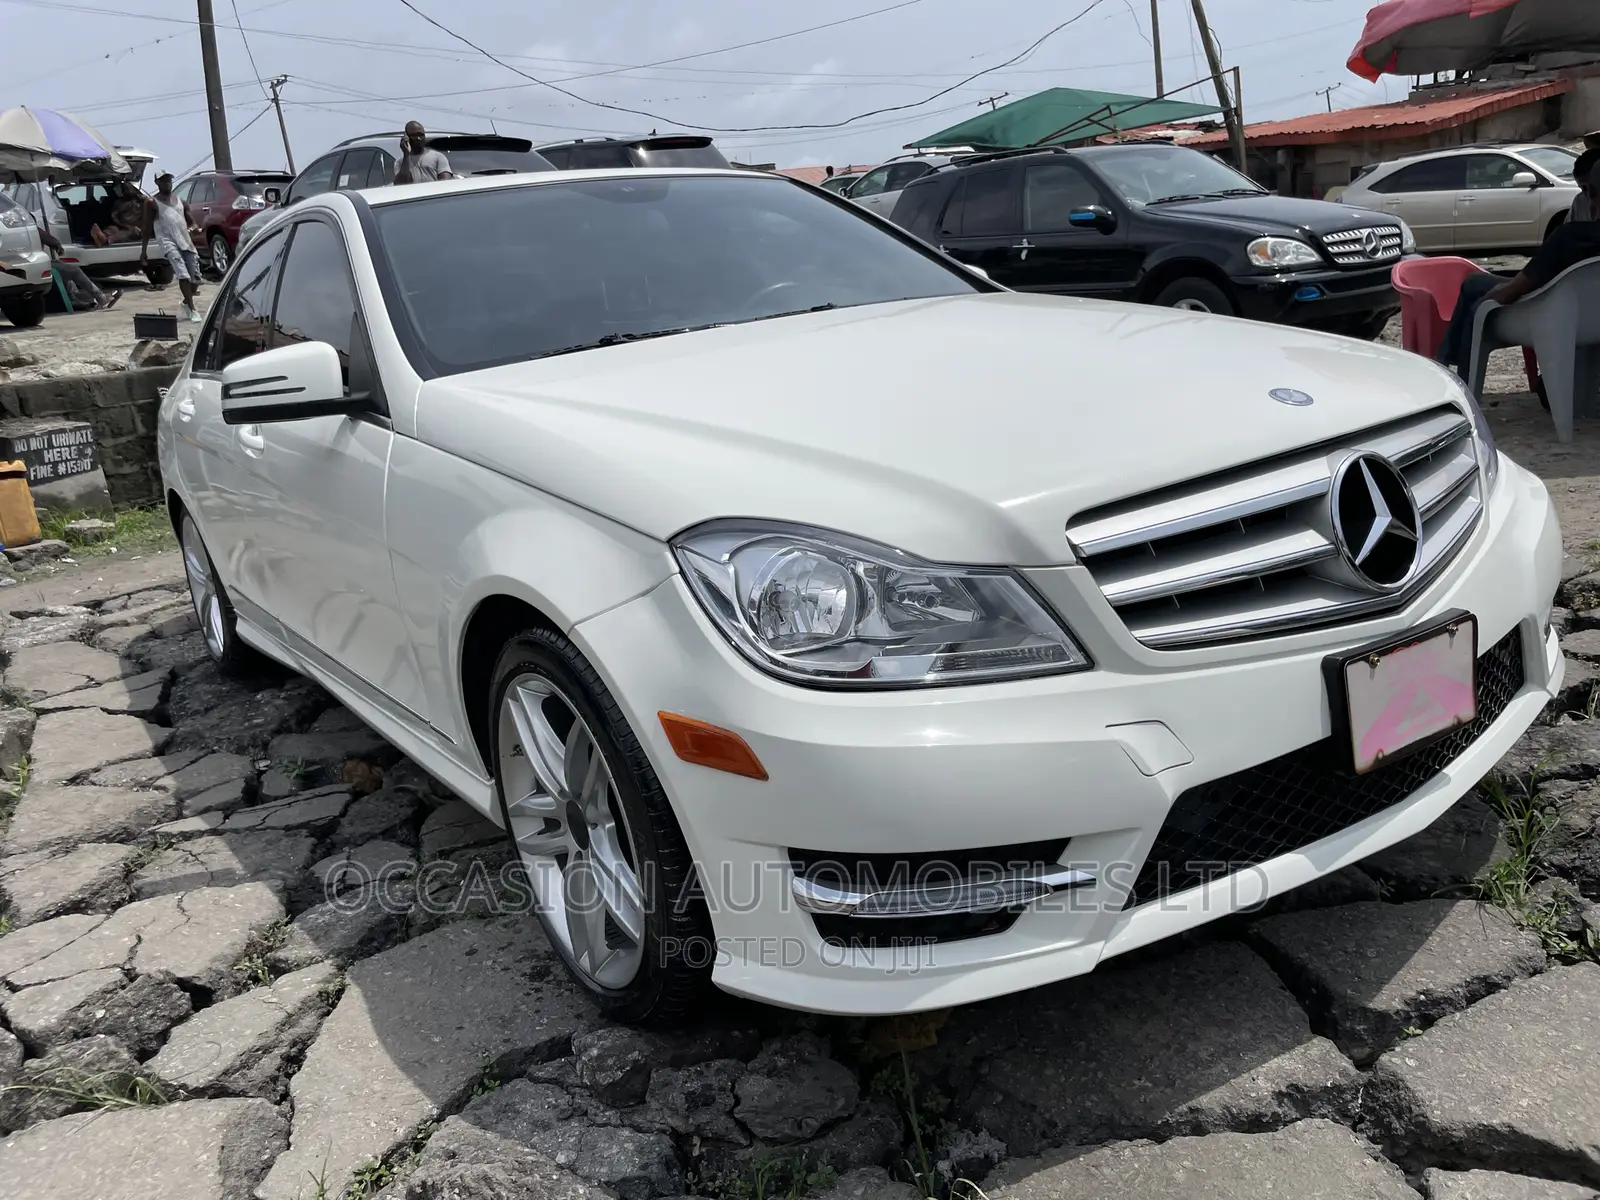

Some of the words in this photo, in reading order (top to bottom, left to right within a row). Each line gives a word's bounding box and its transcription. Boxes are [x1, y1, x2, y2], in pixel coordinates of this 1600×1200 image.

[14, 439, 28, 453] DO
[29, 436, 48, 451] NOT
[51, 429, 93, 447] URINATE
[43, 446, 79, 463] HERE
[30, 465, 54, 480] FINE
